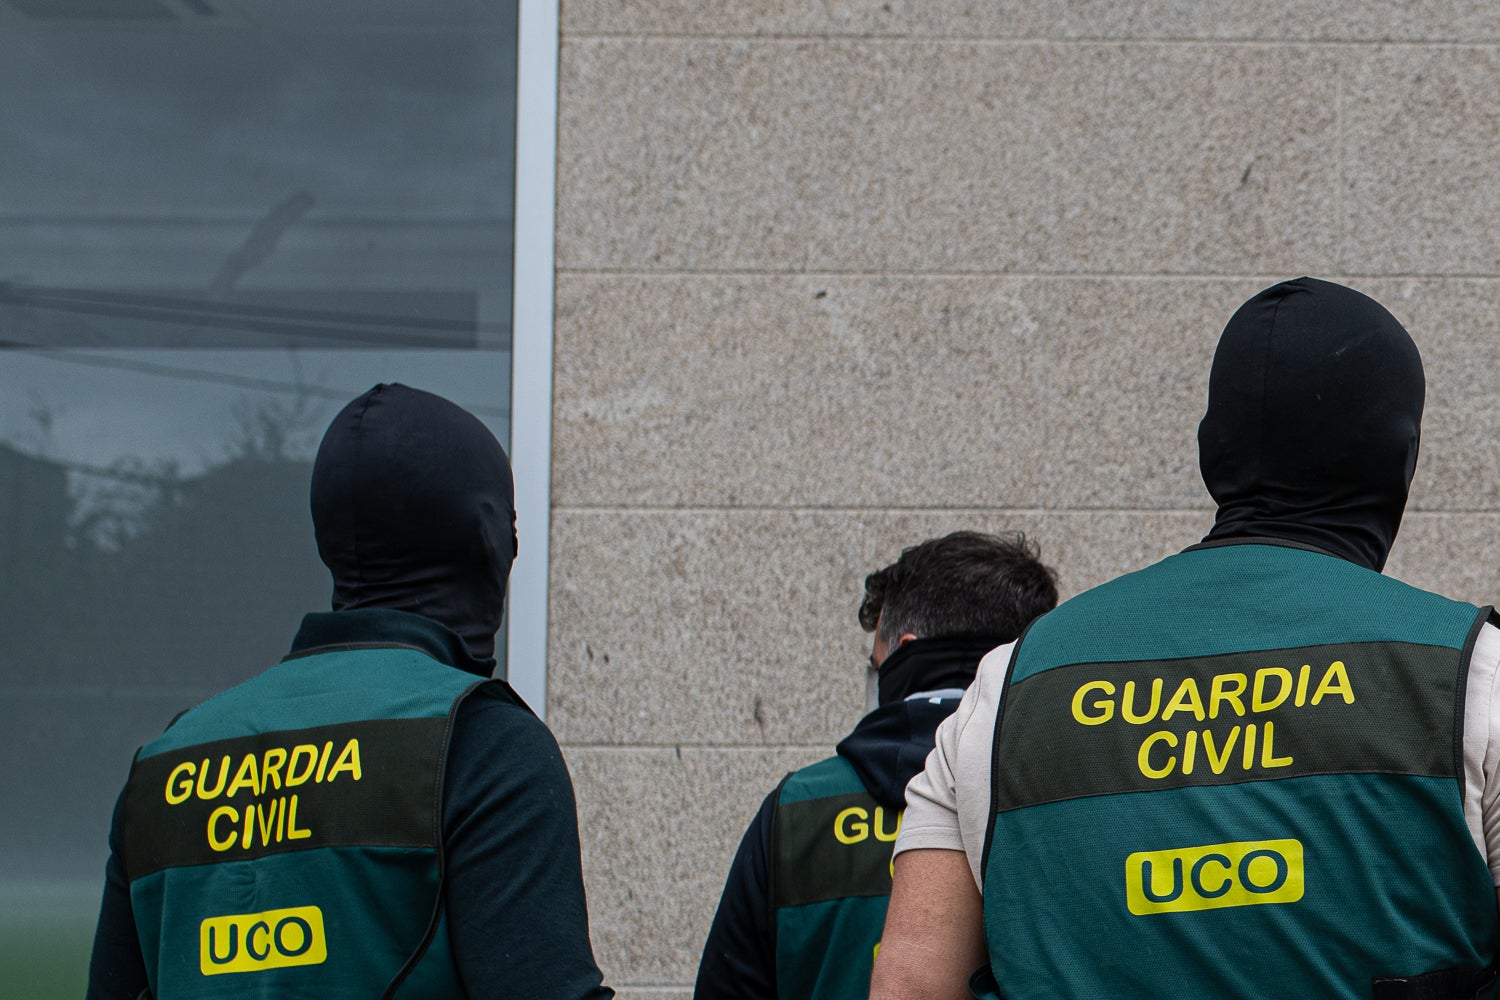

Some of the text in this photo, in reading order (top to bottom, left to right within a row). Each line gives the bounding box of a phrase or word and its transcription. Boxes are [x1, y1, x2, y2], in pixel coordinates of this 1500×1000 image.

[1072, 661, 1354, 725] GUARDIA
[165, 739, 361, 805] GUARDIA
[1138, 721, 1294, 779] CIVIL
[207, 795, 312, 852] CIVIL
[1140, 849, 1289, 904] UCO
[207, 916, 313, 965] UCO
